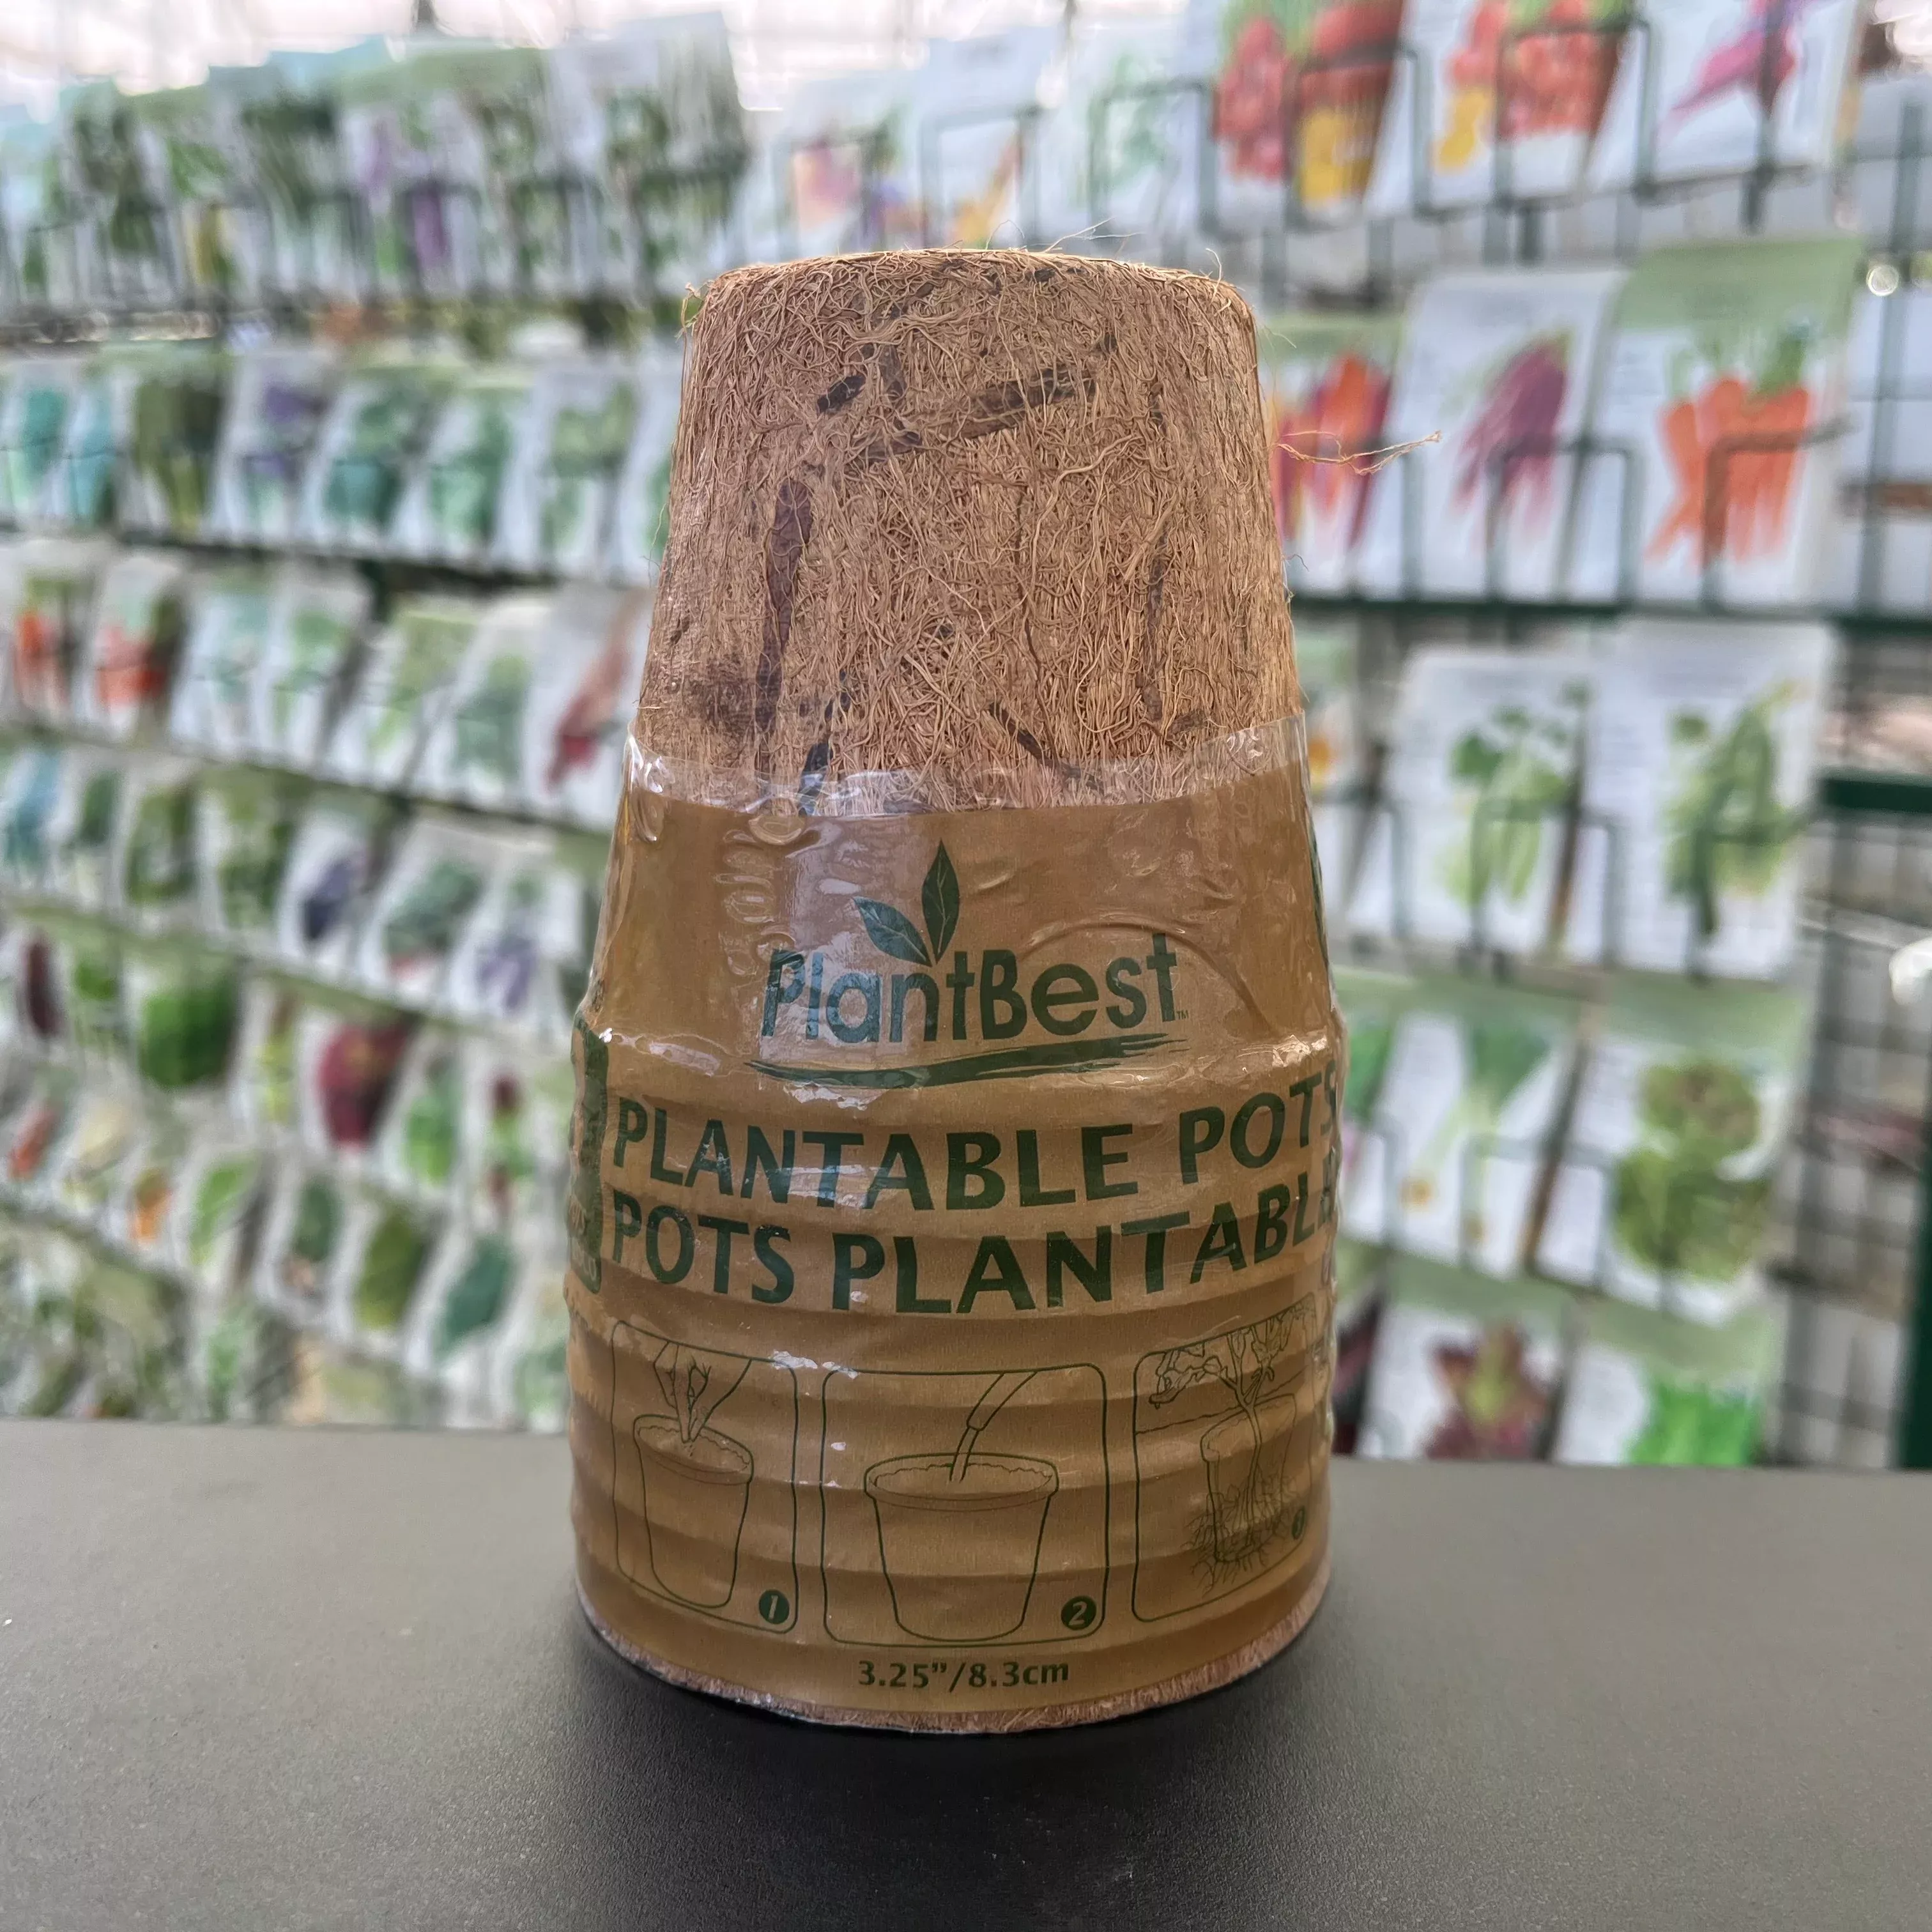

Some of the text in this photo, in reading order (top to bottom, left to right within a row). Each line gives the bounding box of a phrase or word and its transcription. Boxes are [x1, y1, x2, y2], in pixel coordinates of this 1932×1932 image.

[760, 933, 1177, 1044] PlantBest
[613, 1059, 1336, 1211] PLANTABLE POTS
[612, 1188, 795, 1304] POTS
